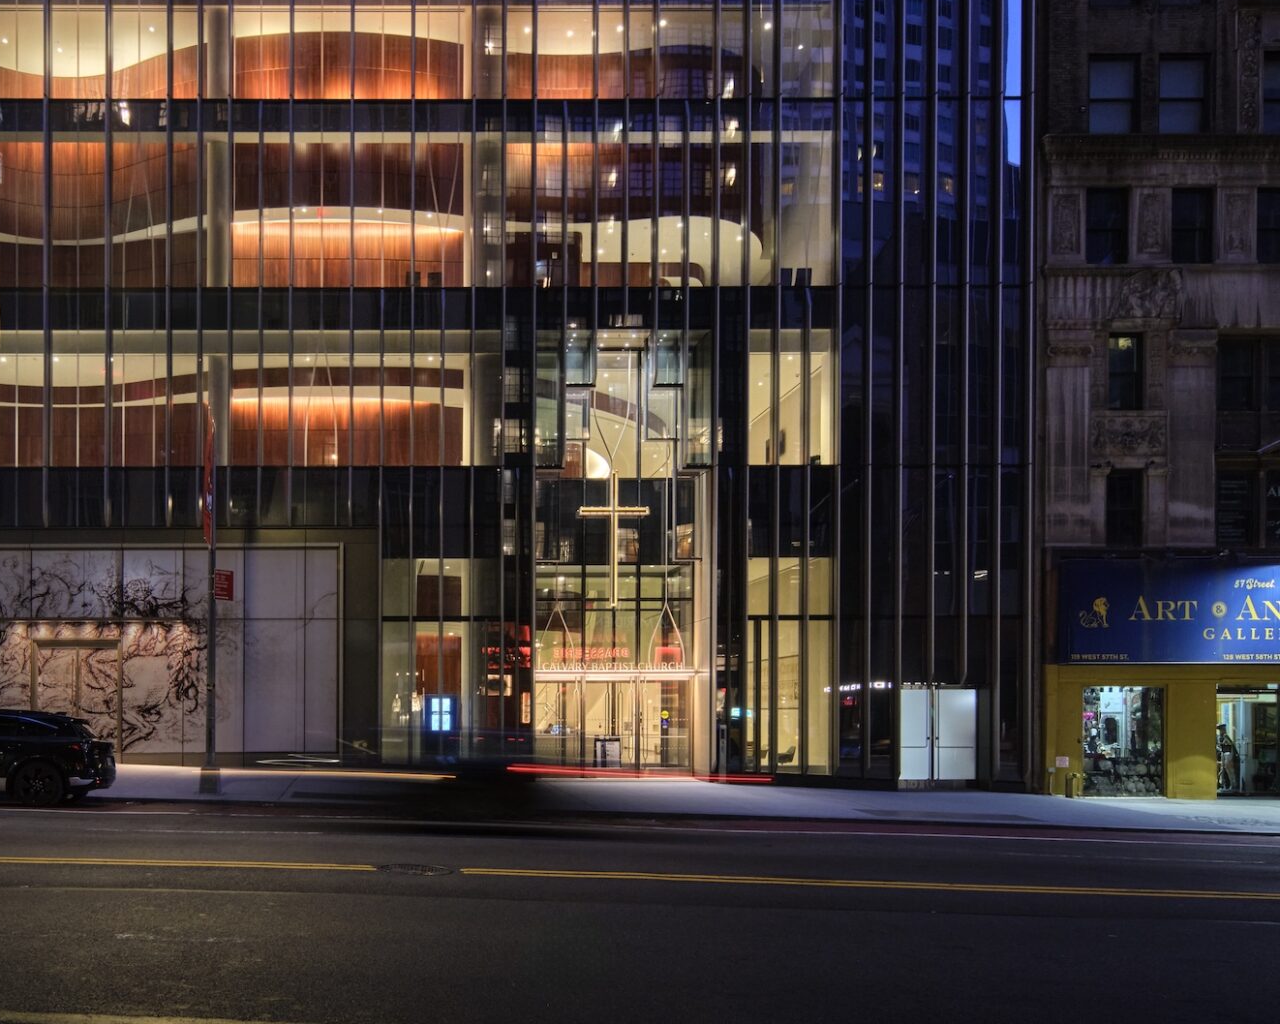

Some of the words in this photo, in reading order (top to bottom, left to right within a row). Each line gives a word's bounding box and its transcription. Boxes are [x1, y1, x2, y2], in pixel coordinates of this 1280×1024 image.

[1234, 579, 1245, 589] 57
[1246, 578, 1275, 590] Street
[1203, 627, 1280, 641] GALLE
[1082, 653, 1100, 661] WEST
[1102, 653, 1119, 661] 57TH
[1235, 653, 1254, 661] WEST
[542, 661, 588, 672] CALVARY
[591, 661, 635, 672] BAPTIST
[637, 661, 683, 672] CHURCH
